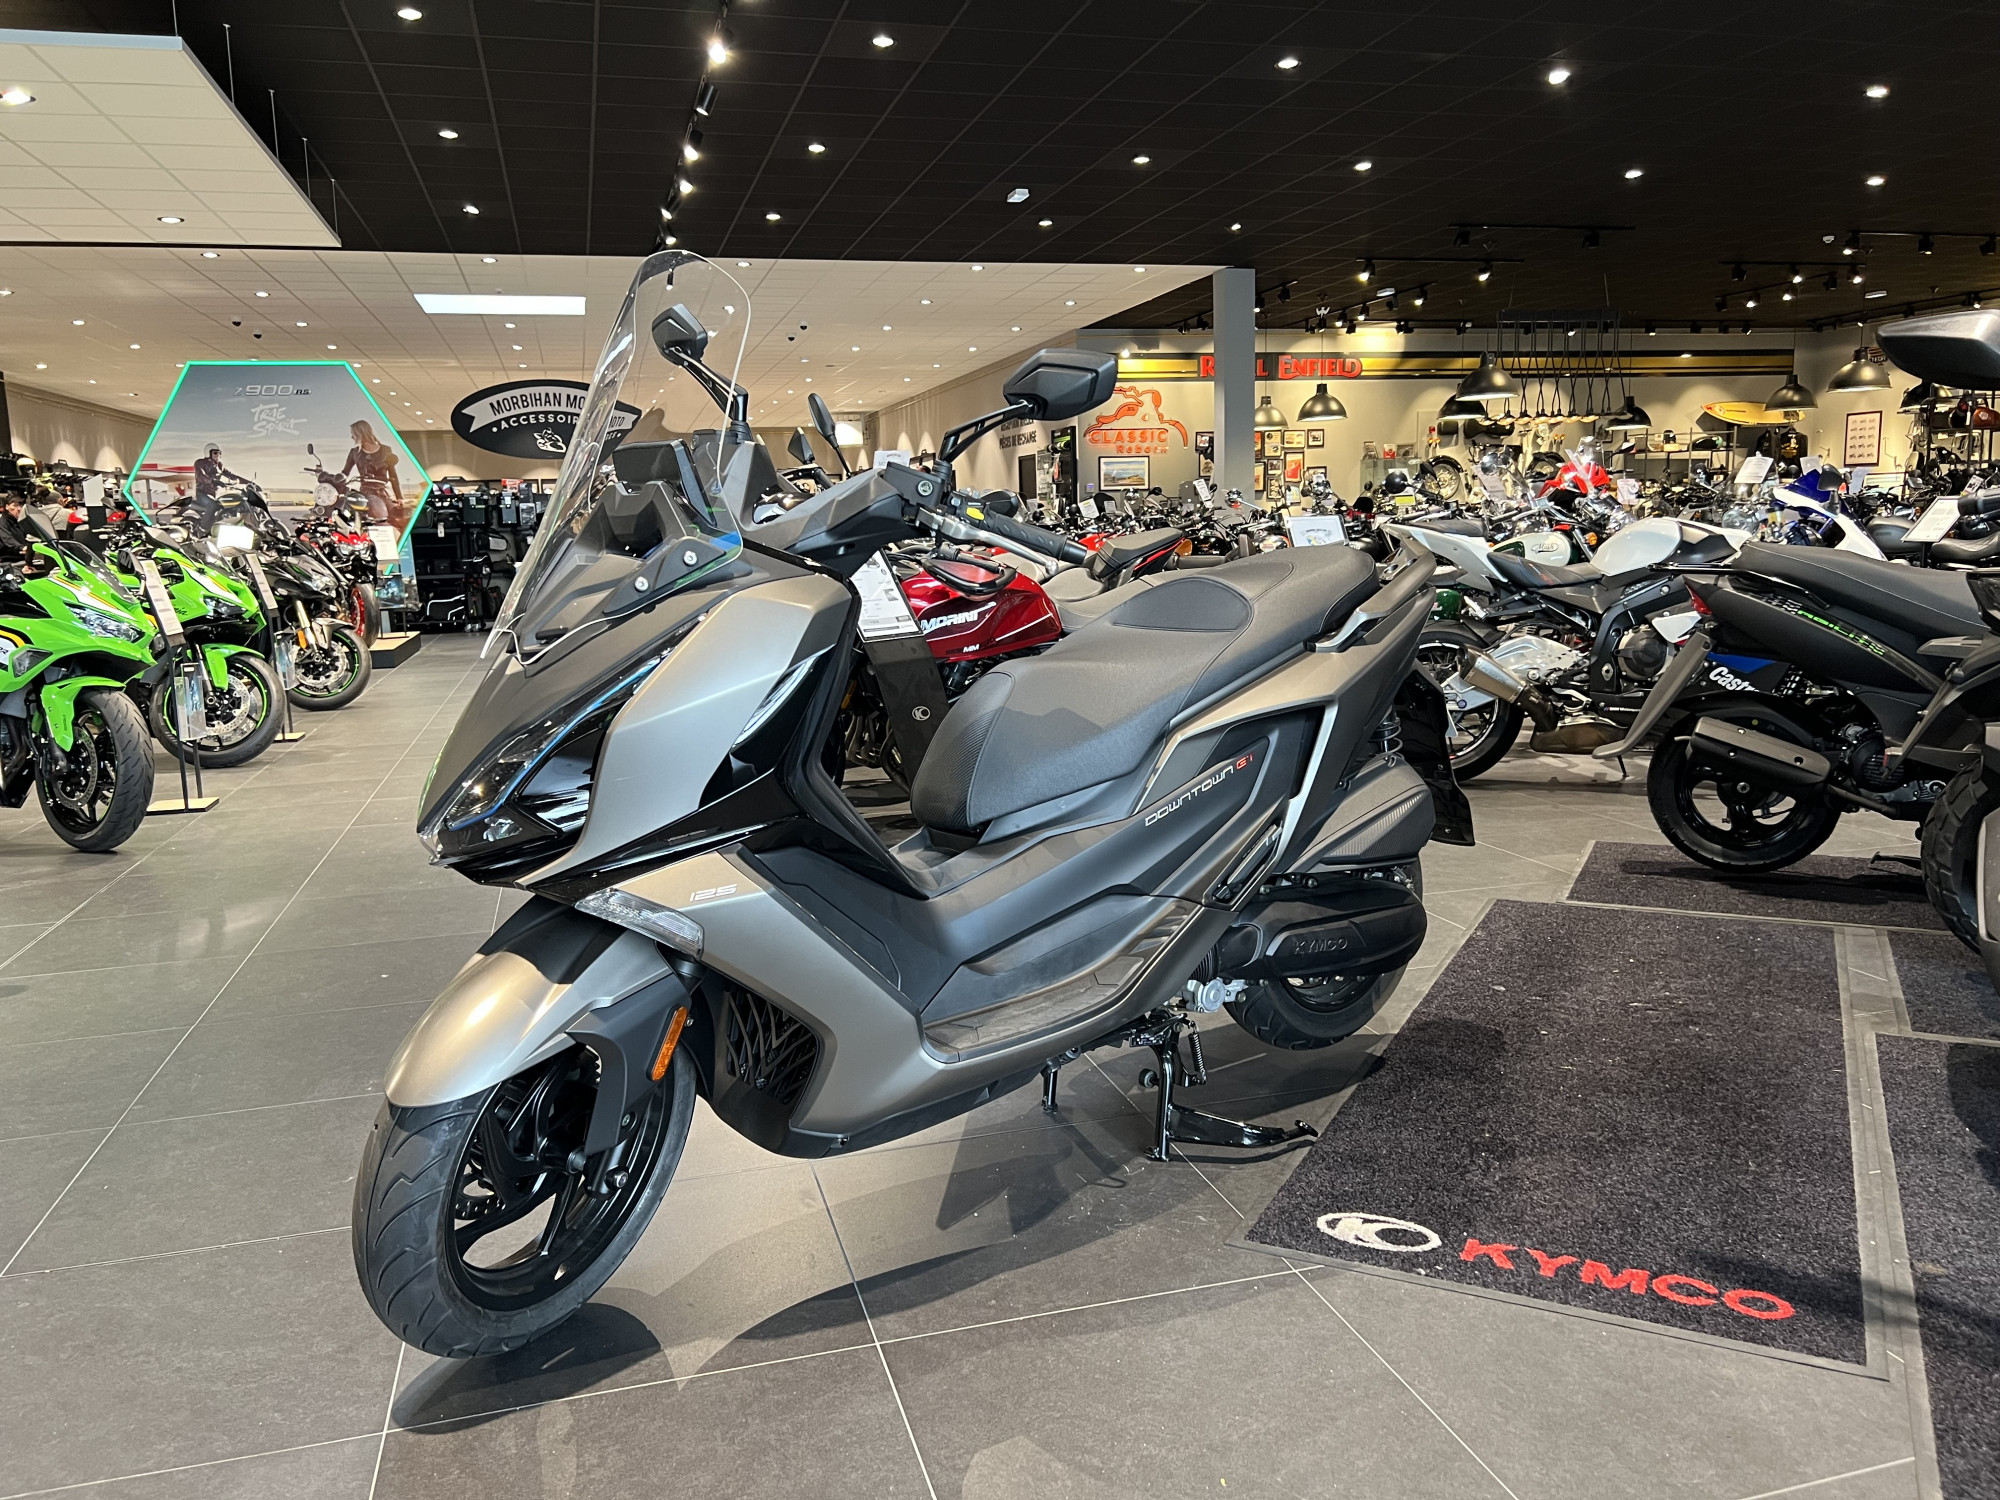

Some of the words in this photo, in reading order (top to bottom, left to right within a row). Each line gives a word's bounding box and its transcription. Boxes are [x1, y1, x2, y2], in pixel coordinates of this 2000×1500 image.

[1278, 354, 1363, 380] ENFIELD
[489, 392, 562, 417] MORBIHAN
[501, 413, 579, 430] ACCESSOIR
[1089, 430, 1168, 444] CLASSIC
[921, 608, 982, 631] MORINI
[1145, 765, 1234, 827] DOWNTOWN
[1236, 752, 1254, 770] GT
[689, 883, 738, 902] 125
[1294, 939, 1349, 955] KYMCO
[1459, 1238, 1796, 1320] KYMCO
